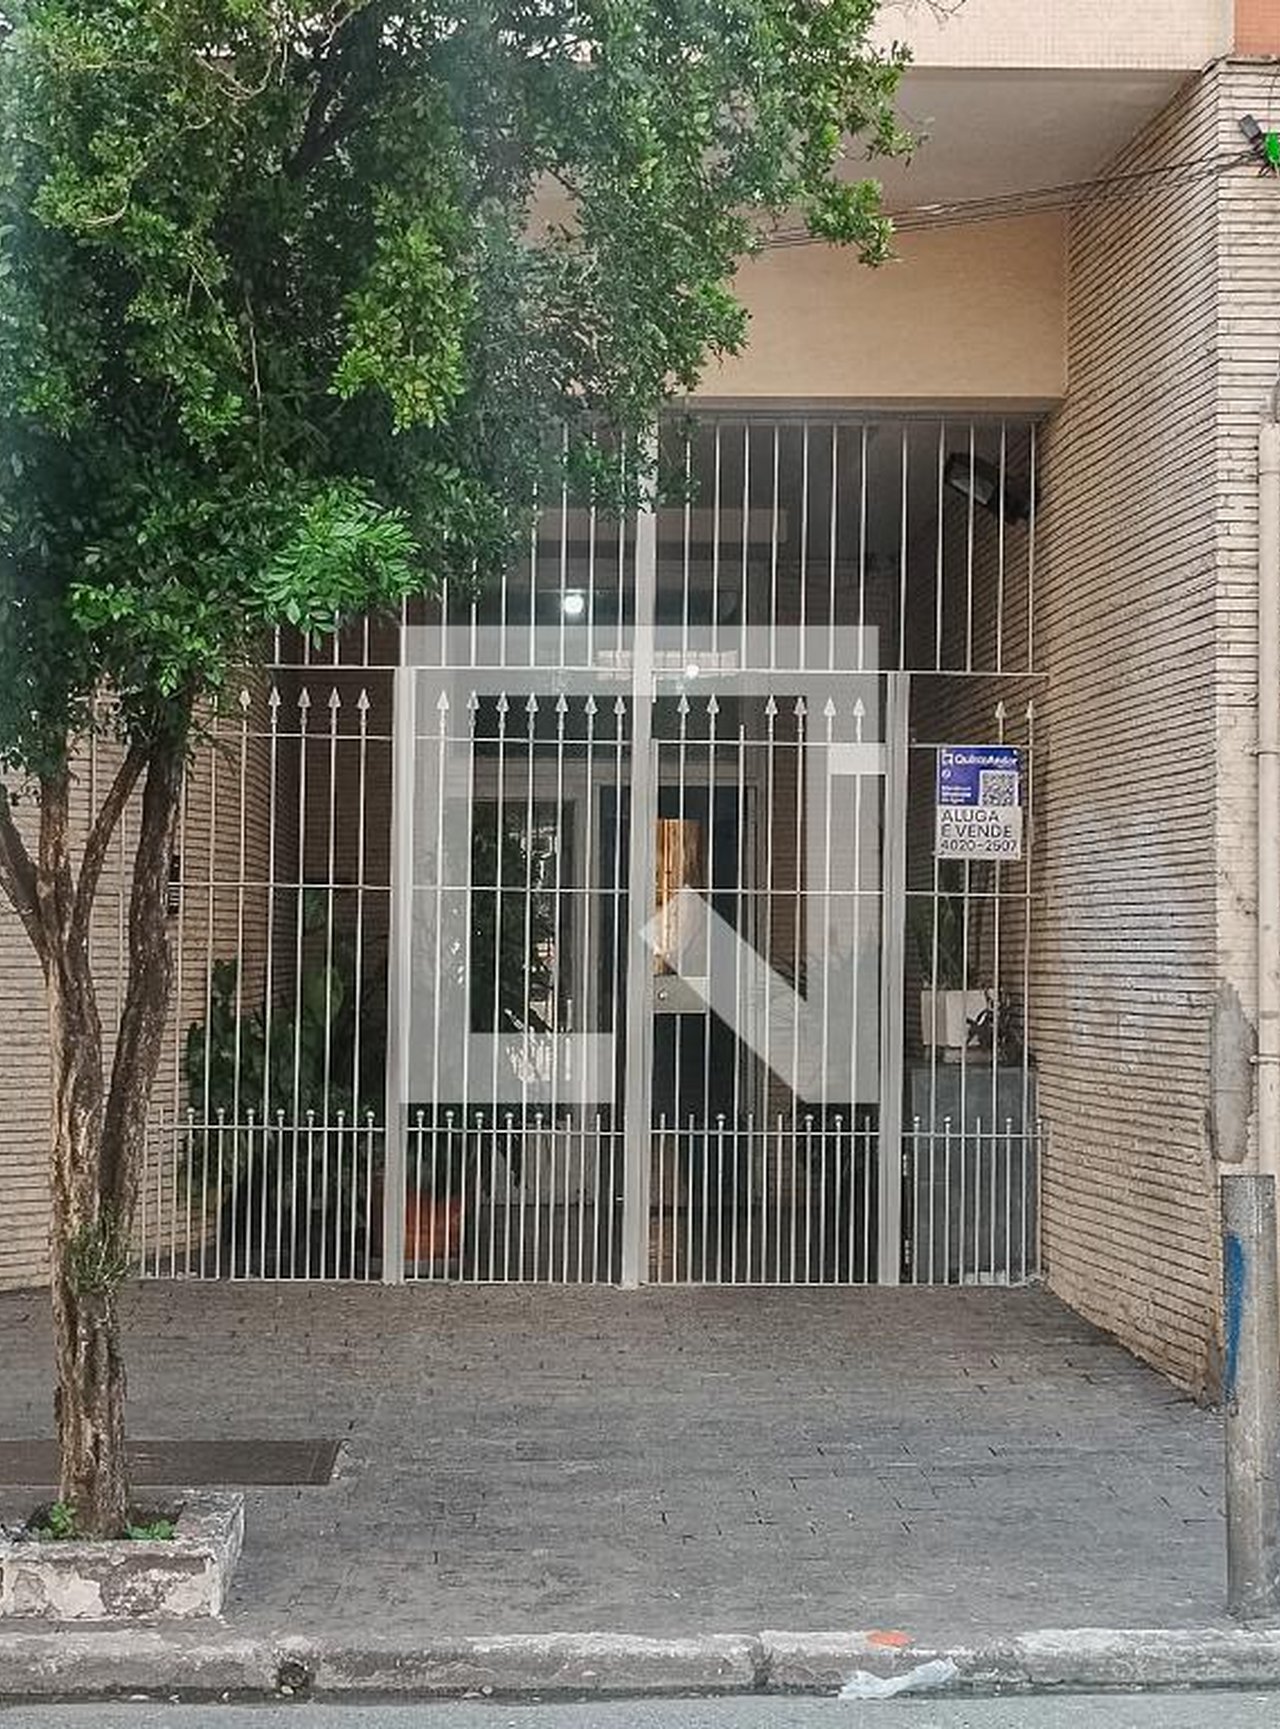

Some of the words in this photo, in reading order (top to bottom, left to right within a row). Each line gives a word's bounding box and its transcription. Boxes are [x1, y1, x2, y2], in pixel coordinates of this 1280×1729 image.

[941, 809, 999, 822] ALUGA
[941, 824, 951, 838] E
[955, 824, 1012, 838] VENDE
